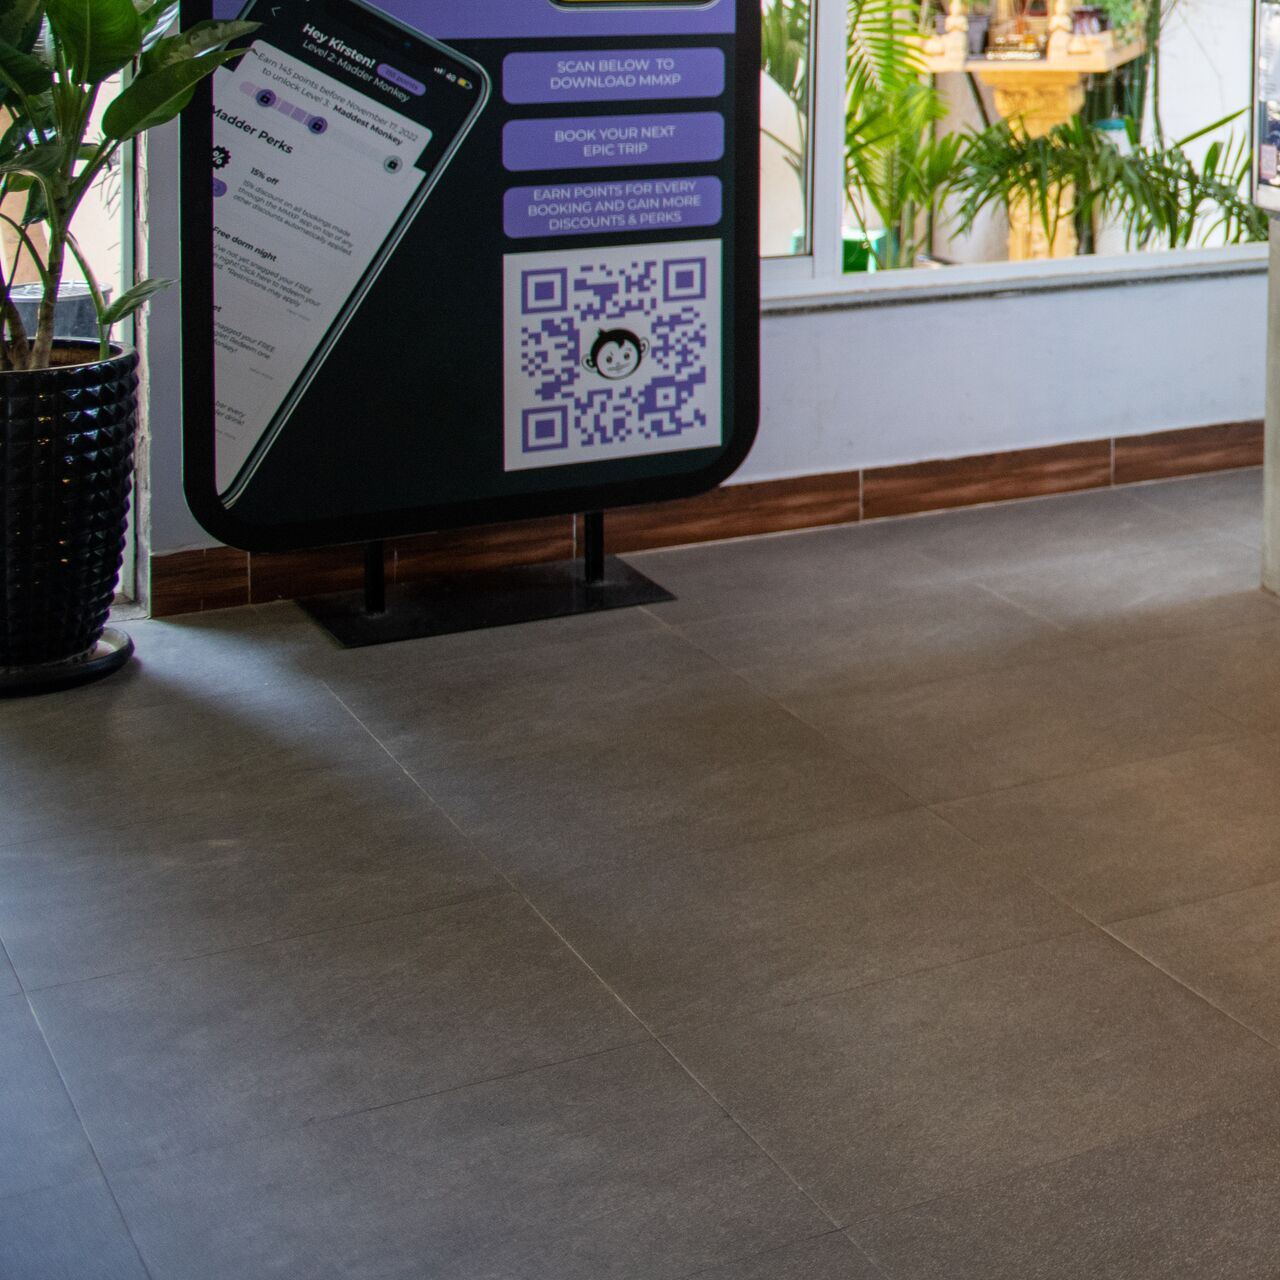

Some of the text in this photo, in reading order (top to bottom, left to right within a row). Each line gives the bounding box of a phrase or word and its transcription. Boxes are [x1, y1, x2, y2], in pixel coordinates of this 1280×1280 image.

[302, 23, 328, 44] Hey
[328, 37, 376, 68] Kirsten!
[302, 39, 410, 103] Level 2: Madder Monkey
[557, 58, 674, 73] SCAN BELOW TO
[257, 52, 278, 68] Earn
[278, 63, 293, 76] 145
[292, 72, 319, 90] points
[319, 85, 346, 103] before
[346, 99, 388, 125] November
[551, 73, 681, 89] DOWNLOAD MMXP
[332, 104, 369, 128] Maddest
[370, 124, 403, 146] Monkey
[555, 126, 676, 142] BOOK YOUR NEXT
[258, 129, 294, 154] Perks
[584, 142, 647, 157] EPIC TRIP
[250, 167, 280, 185] 15% off
[534, 181, 696, 201] EARN POINTS FOR EVERY
[528, 195, 701, 216] BOOKING AND GAIN MORE
[549, 211, 681, 230] DISCOUNTS & PERKS
[211, 226, 277, 262] Free dorm night
